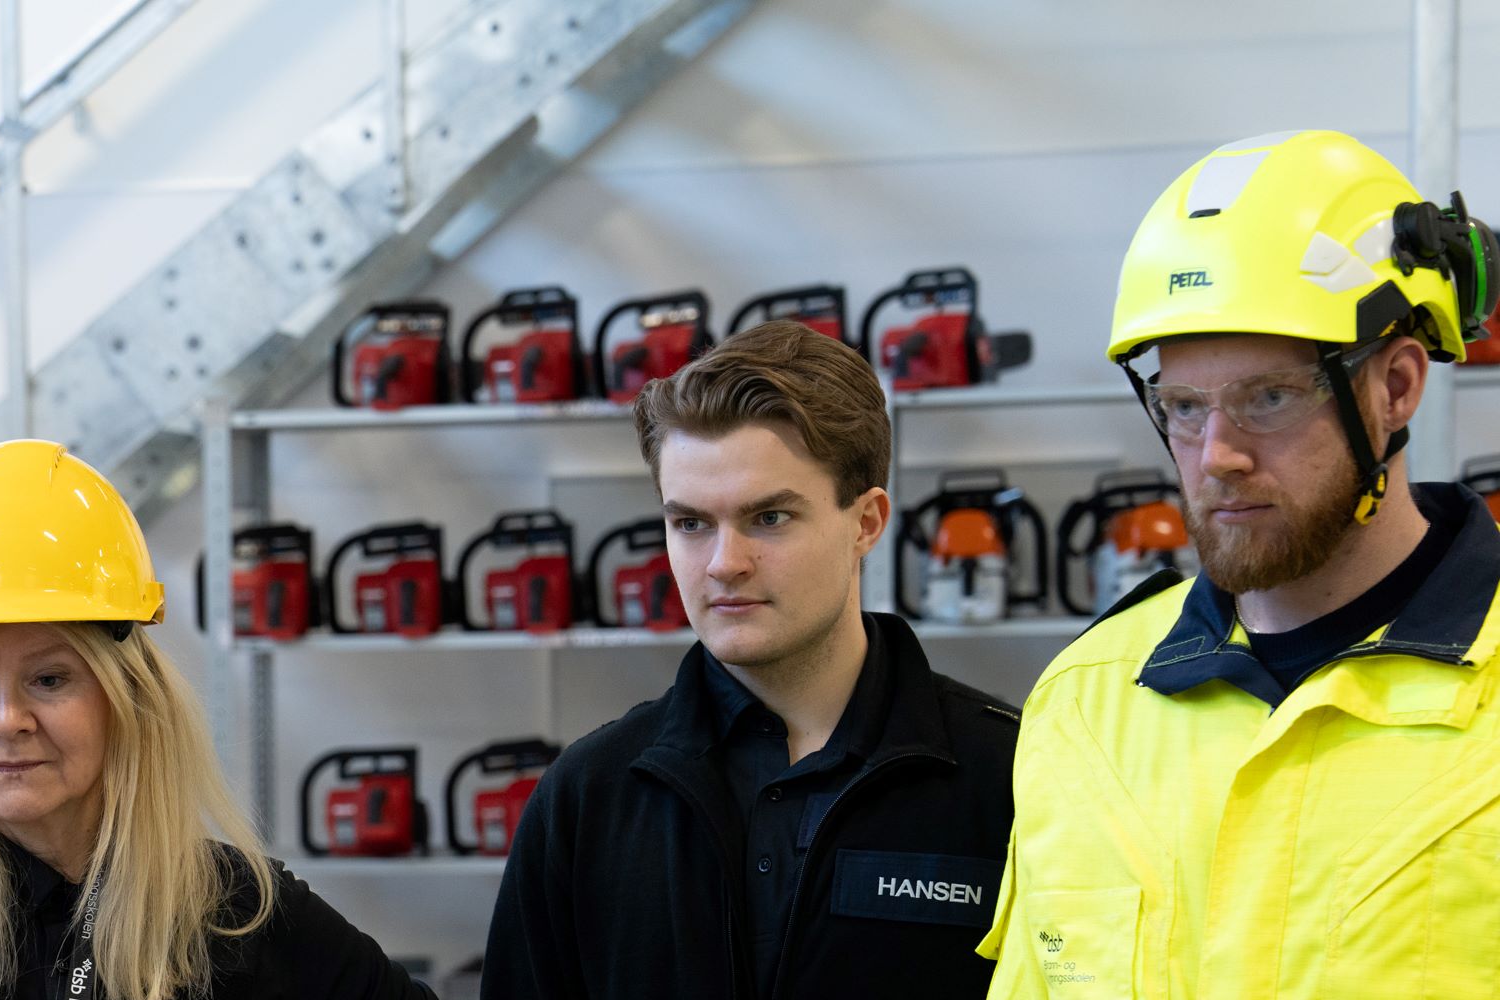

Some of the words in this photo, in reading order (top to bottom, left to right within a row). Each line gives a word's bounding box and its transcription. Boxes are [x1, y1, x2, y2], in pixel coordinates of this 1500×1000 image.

[1169, 271, 1214, 295] PETZL
[878, 876, 982, 905] HANSEN
[70, 967, 88, 995] dsb
